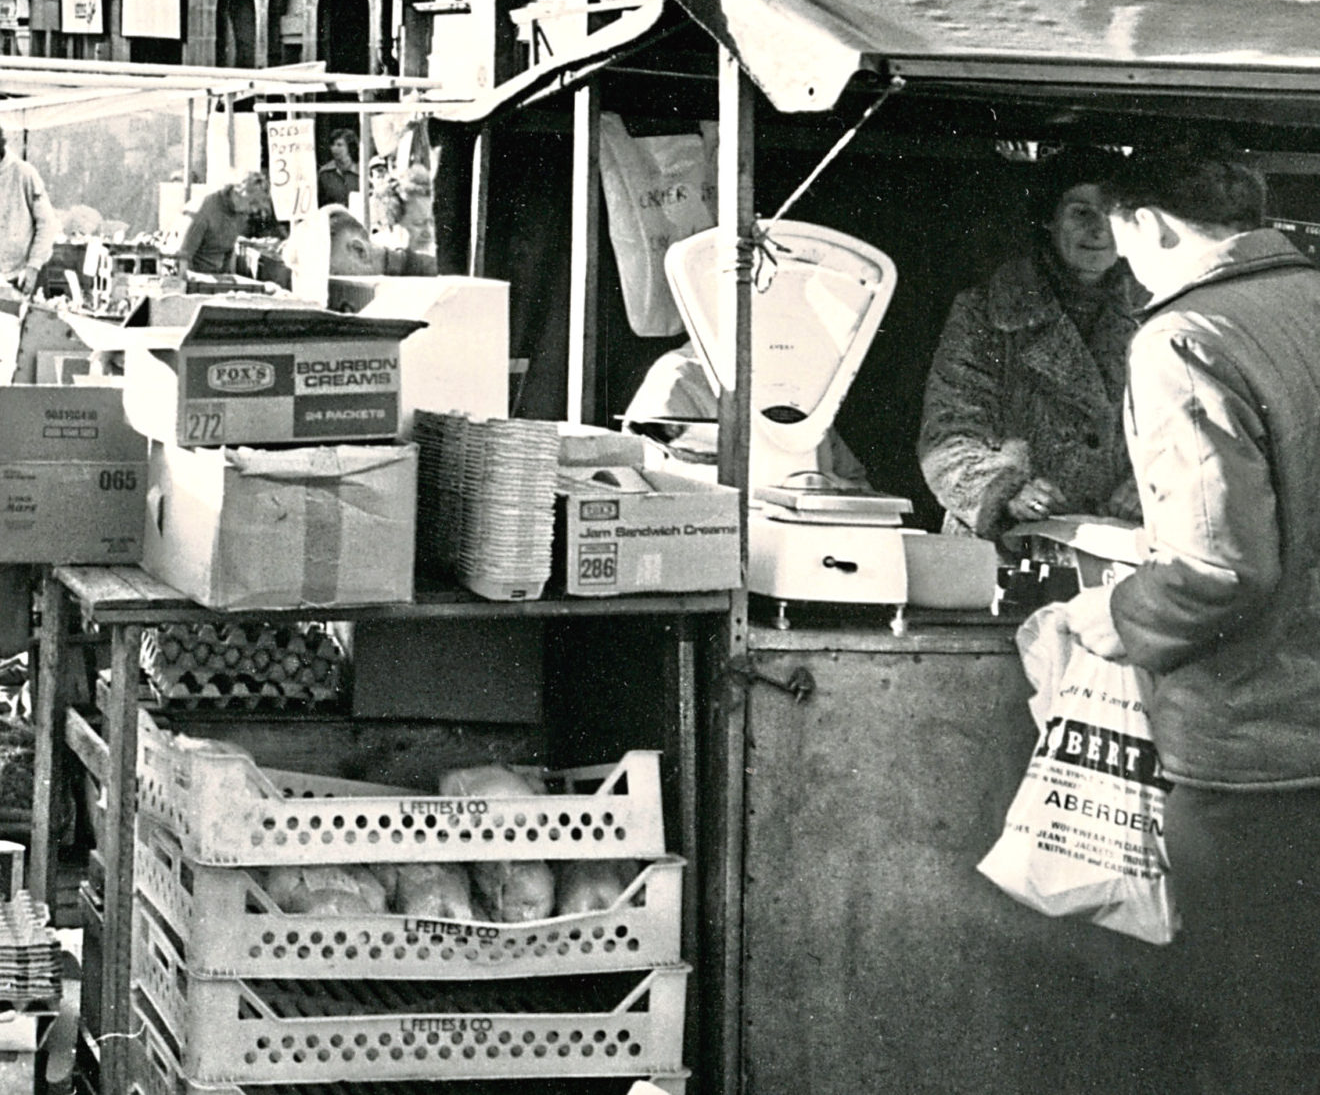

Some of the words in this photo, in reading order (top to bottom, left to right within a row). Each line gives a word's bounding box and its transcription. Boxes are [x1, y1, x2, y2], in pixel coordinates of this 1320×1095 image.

[274, 159, 290, 187] 3
[216, 366, 266, 380] FOX'S
[296, 358, 398, 374] BOURBON
[304, 372, 391, 388] CREAMS
[326, 409, 386, 421] PACKETS
[188, 413, 221, 440] 272
[99, 470, 137, 491] 065
[579, 528, 612, 538] Jam
[615, 525, 680, 537] Sandwich
[683, 524, 738, 536] Creams
[581, 558, 614, 579] 286
[411, 801, 453, 815] FETTES
[416, 919, 461, 935] FETTES
[412, 1018, 456, 1032] FETTES
